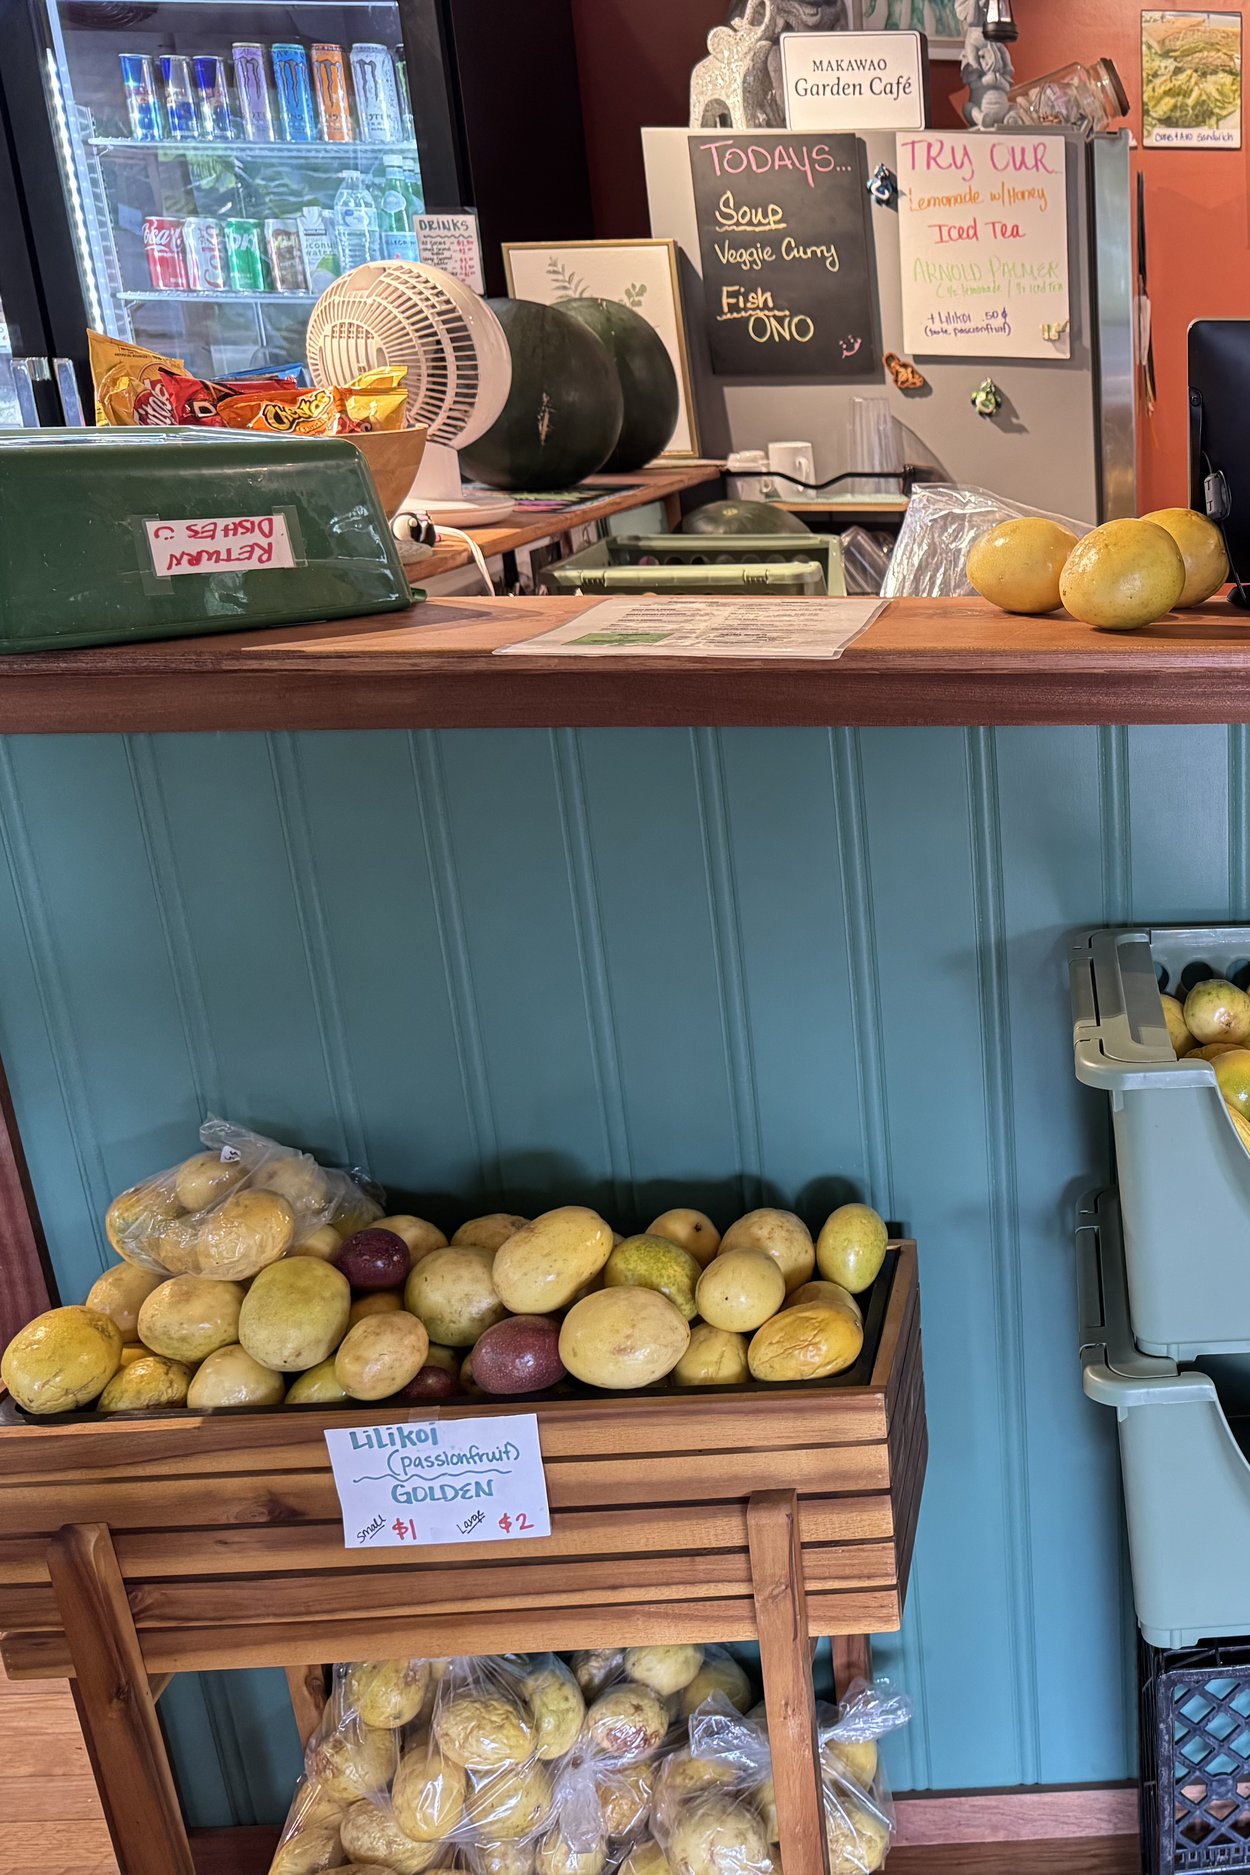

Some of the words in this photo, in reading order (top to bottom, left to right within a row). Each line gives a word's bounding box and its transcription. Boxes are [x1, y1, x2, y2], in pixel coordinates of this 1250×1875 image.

[812, 58, 887, 72] MAKAWAO
[794, 77, 863, 97] Garden
[869, 75, 913, 101] Café
[901, 139, 975, 182] TRY
[715, 190, 783, 227] Soup
[908, 185, 984, 212] Lemonade
[418, 218, 470, 231] DRINKS
[928, 217, 980, 244] Iced
[985, 221, 1026, 240] Tea
[714, 239, 776, 270] Veggie
[781, 237, 840, 272] Curry
[913, 257, 982, 283] ARNOLD
[989, 255, 1059, 280] PALMER
[722, 286, 774, 313] Fish
[749, 314, 815, 342] ONO
[185, 517, 273, 541] DISHES
[166, 542, 273, 571] RETURN
[386, 1441, 520, 1476] (passionfruit)
[391, 1478, 495, 1504] GOLDEN
[391, 1517, 417, 1541] $1
[498, 1513, 534, 1534] $2
